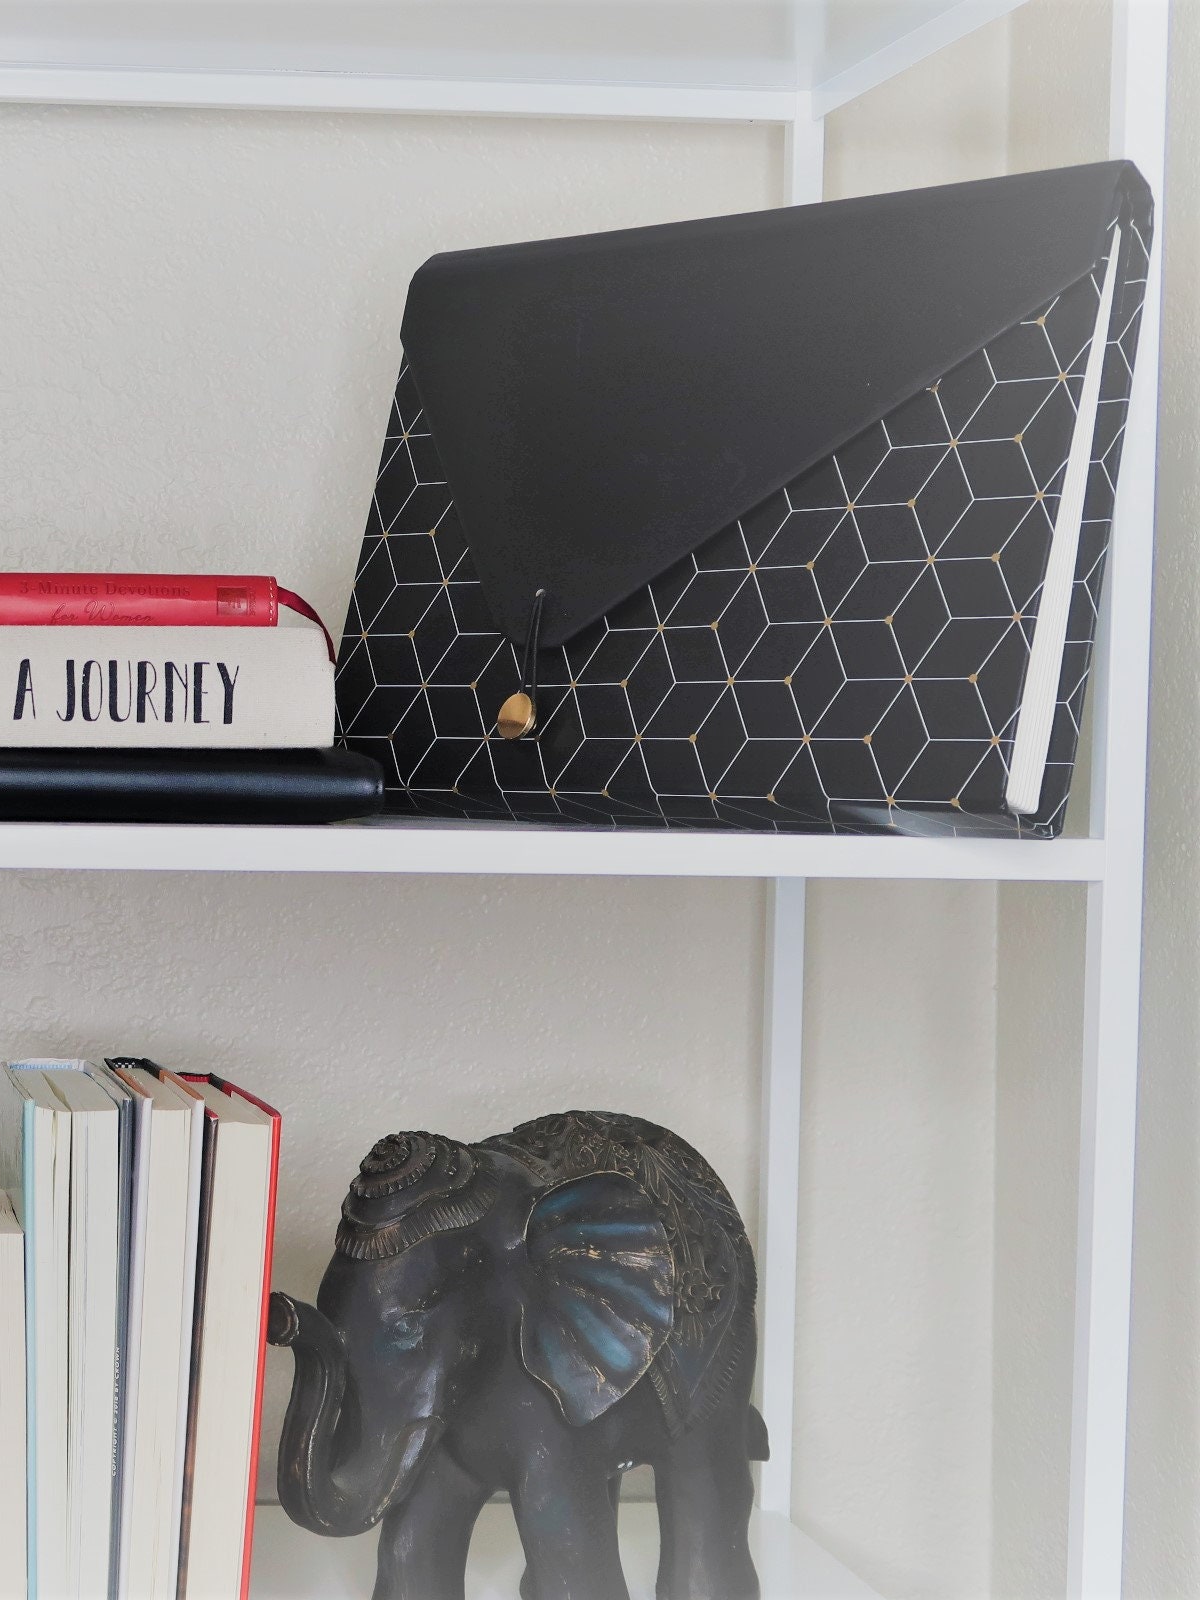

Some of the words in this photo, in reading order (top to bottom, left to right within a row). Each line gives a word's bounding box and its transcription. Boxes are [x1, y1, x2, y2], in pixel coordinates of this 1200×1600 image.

[19, 581, 98, 595] 3-Minute
[105, 582, 192, 597] Devotions
[50, 603, 79, 624] for
[84, 599, 155, 623] Women
[13, 658, 36, 720] A
[56, 659, 240, 725] JOURNEY
